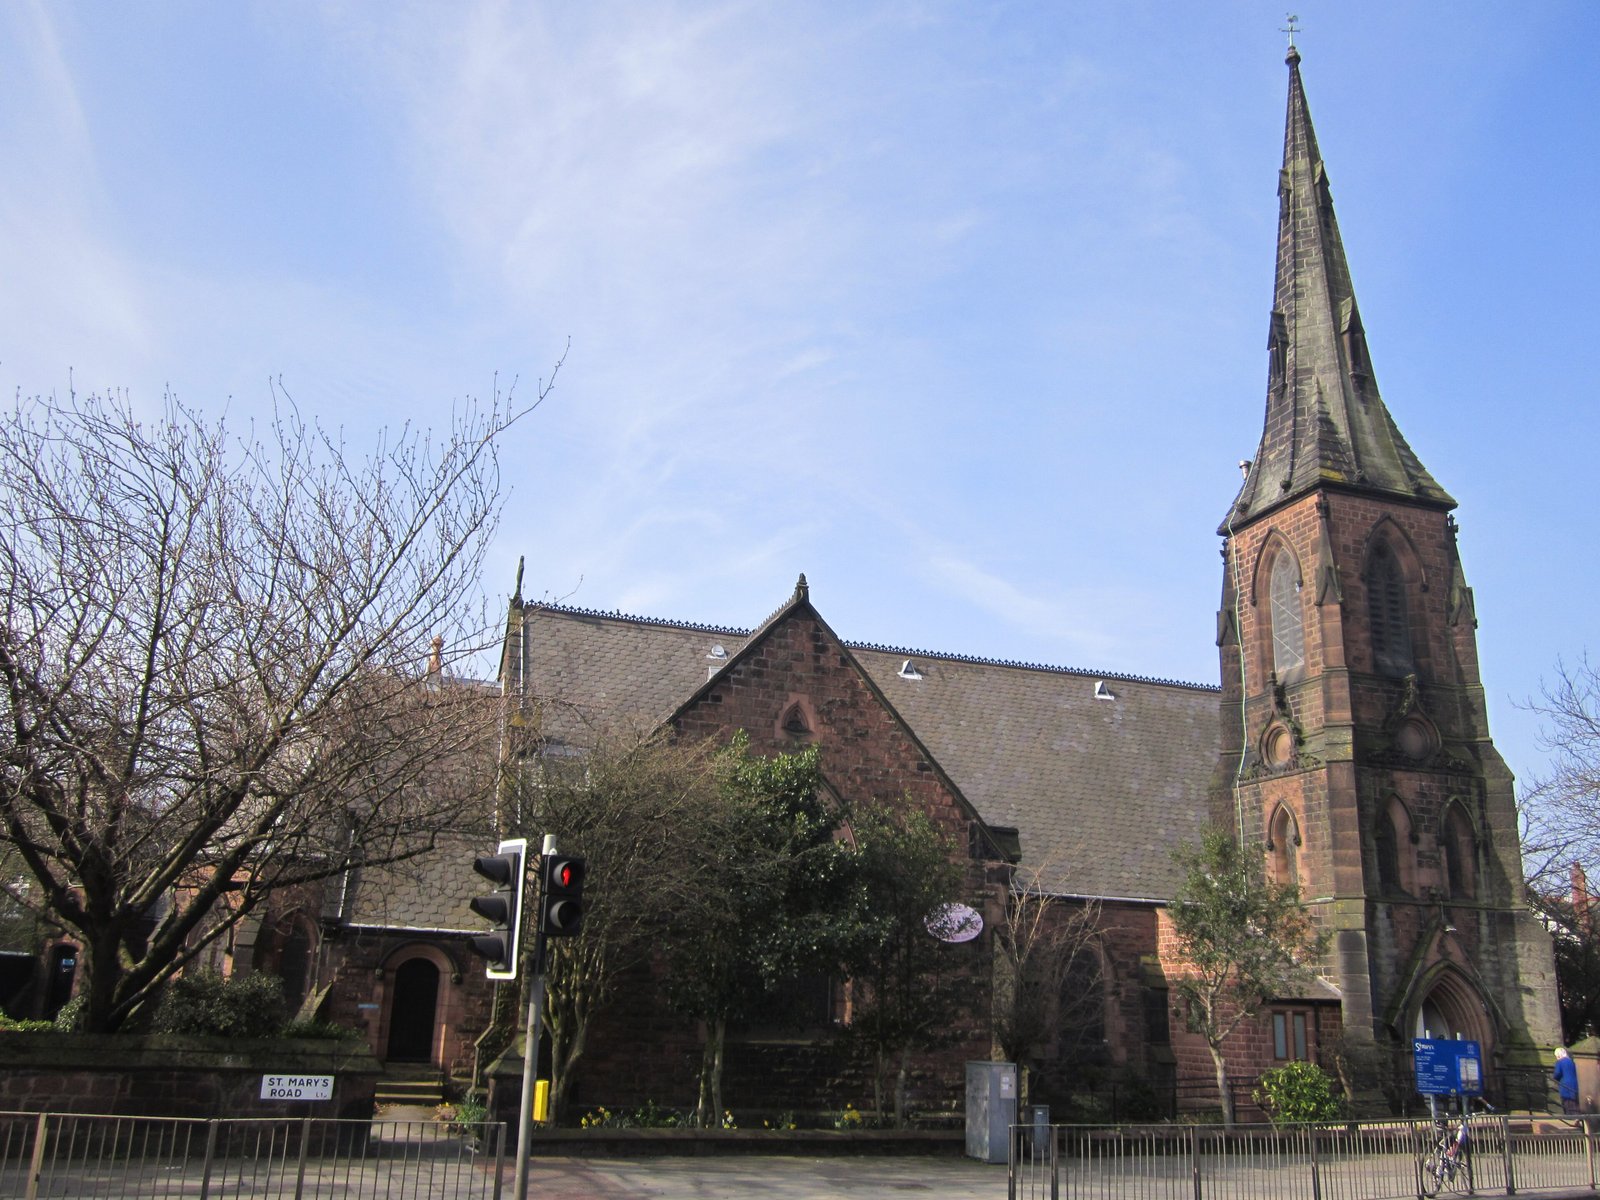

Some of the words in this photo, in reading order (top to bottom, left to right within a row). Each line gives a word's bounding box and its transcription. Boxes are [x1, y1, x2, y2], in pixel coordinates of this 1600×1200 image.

[268, 1077, 283, 1087] ST.
[288, 1078, 329, 1087] MARY'S
[270, 1088, 302, 1098] ROAD
